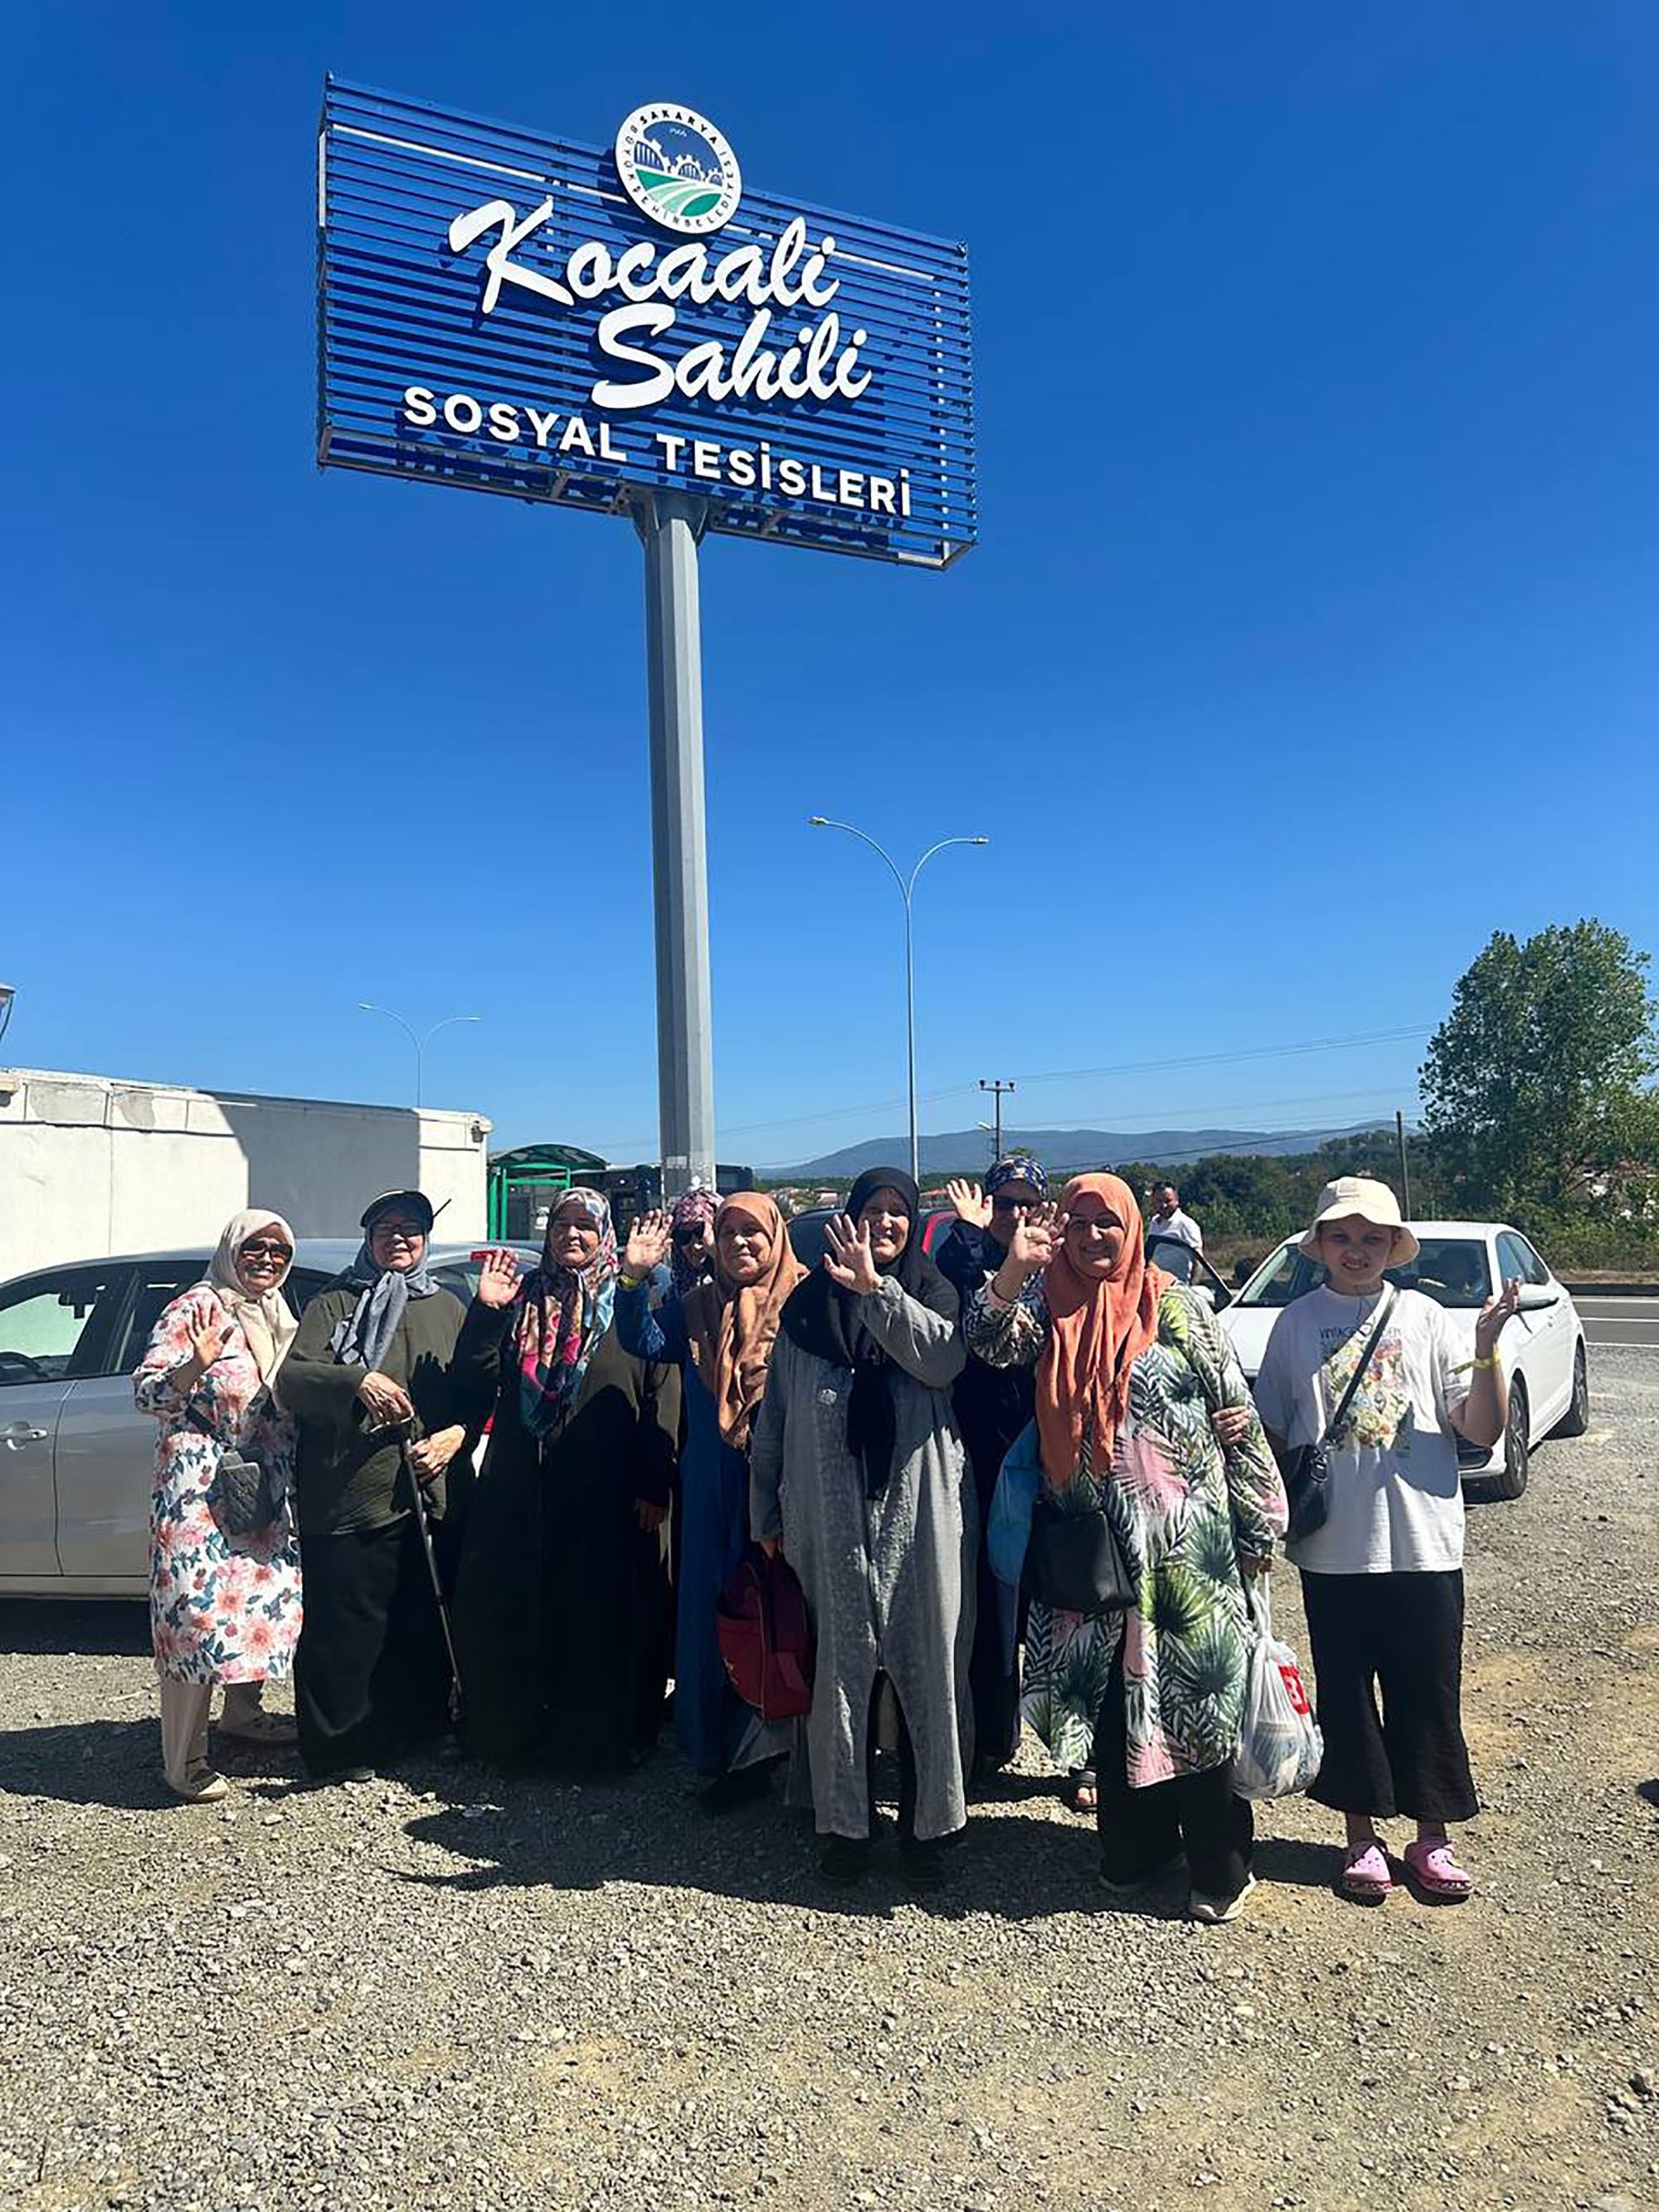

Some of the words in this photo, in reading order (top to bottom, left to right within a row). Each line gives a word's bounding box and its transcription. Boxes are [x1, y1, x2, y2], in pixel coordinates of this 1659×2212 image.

[640, 109, 718, 144] SAKARYA
[450, 200, 839, 314] Kocaali
[592, 303, 871, 409] Sahili
[405, 387, 627, 462] SOSYAL
[657, 434, 911, 516] TESİSLERİ
